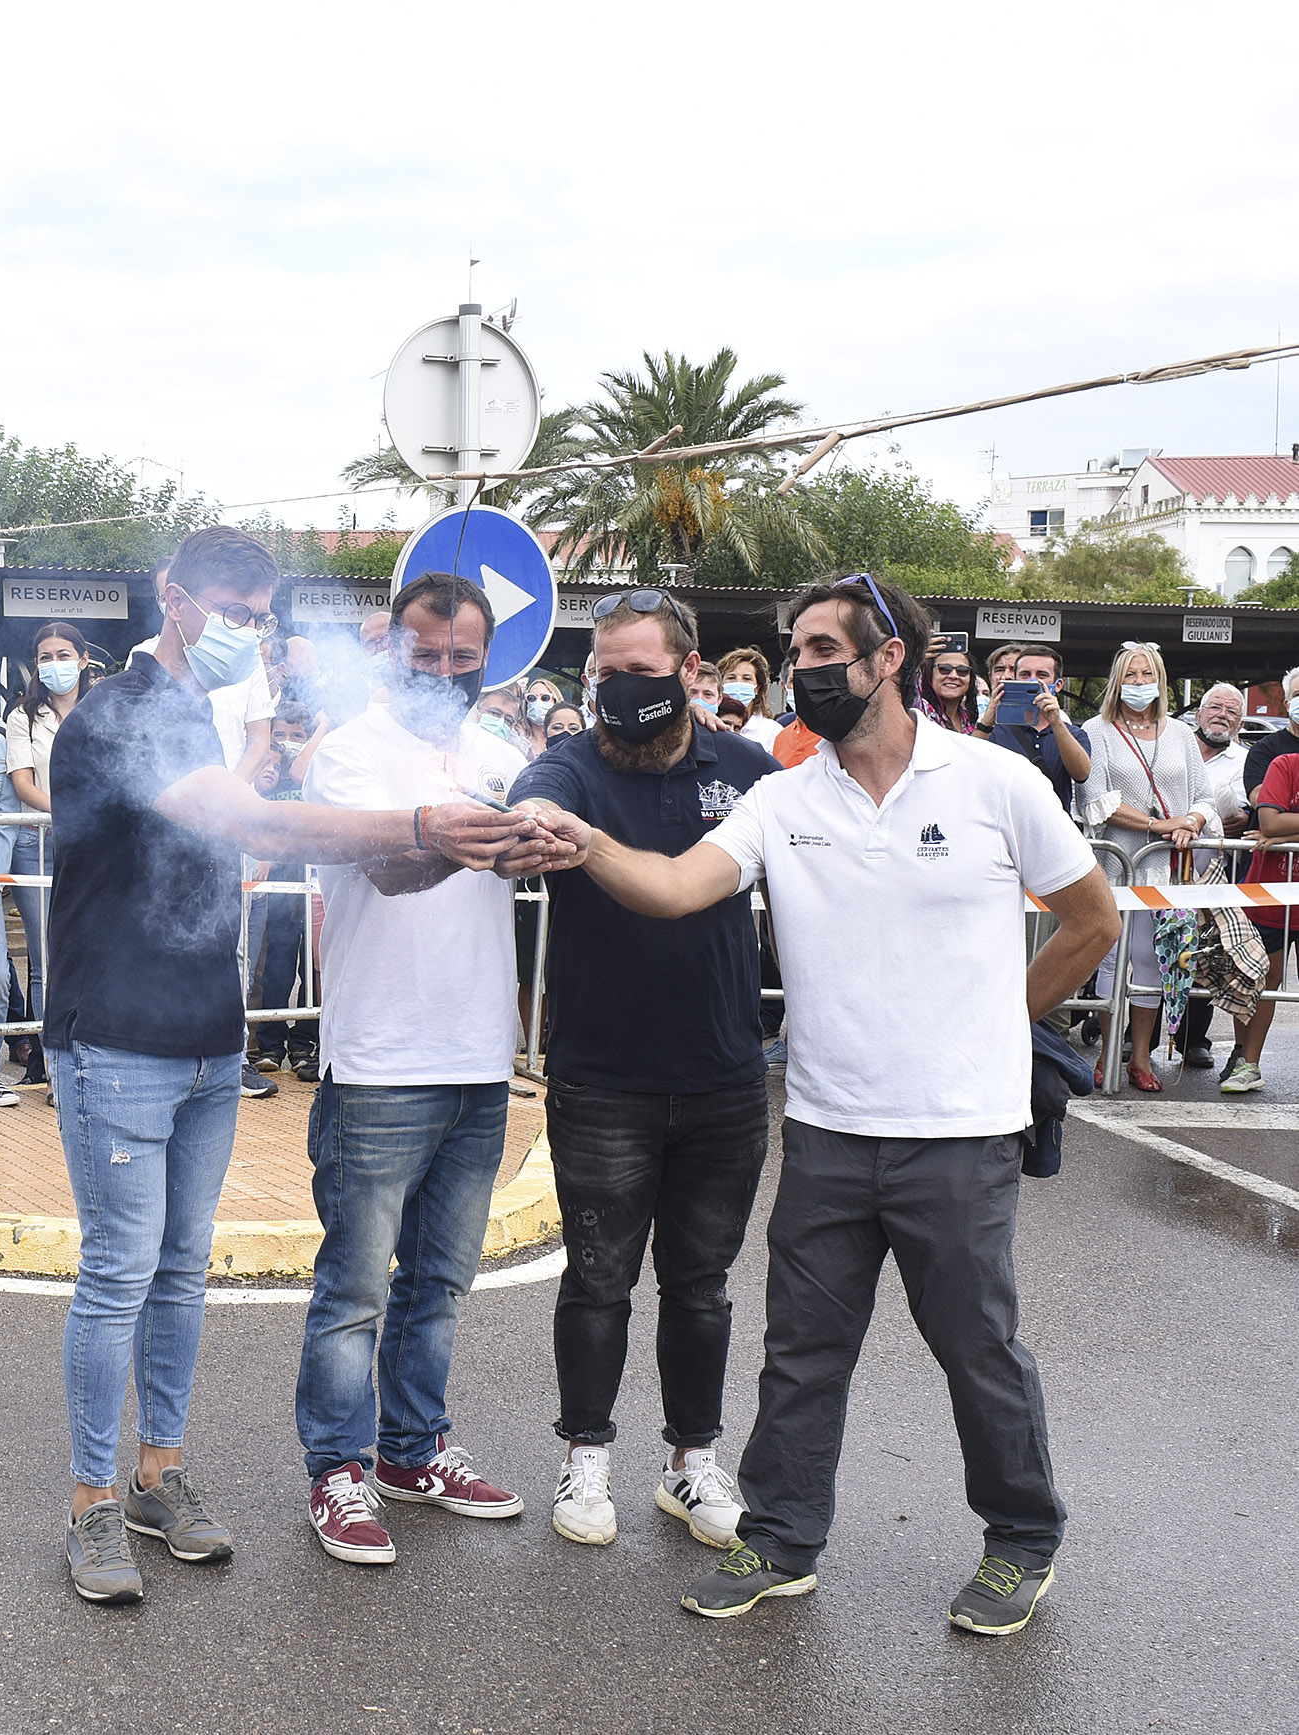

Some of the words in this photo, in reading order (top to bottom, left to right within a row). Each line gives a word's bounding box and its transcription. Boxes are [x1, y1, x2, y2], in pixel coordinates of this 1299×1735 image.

[1027, 480, 1066, 493] TERRAZA
[11, 587, 120, 602] RESERVADO
[982, 612, 1057, 626] RESERVADO
[1185, 618, 1215, 628] RESERVADO
[1216, 618, 1231, 628] LOCAL
[638, 705, 673, 723] Castelló
